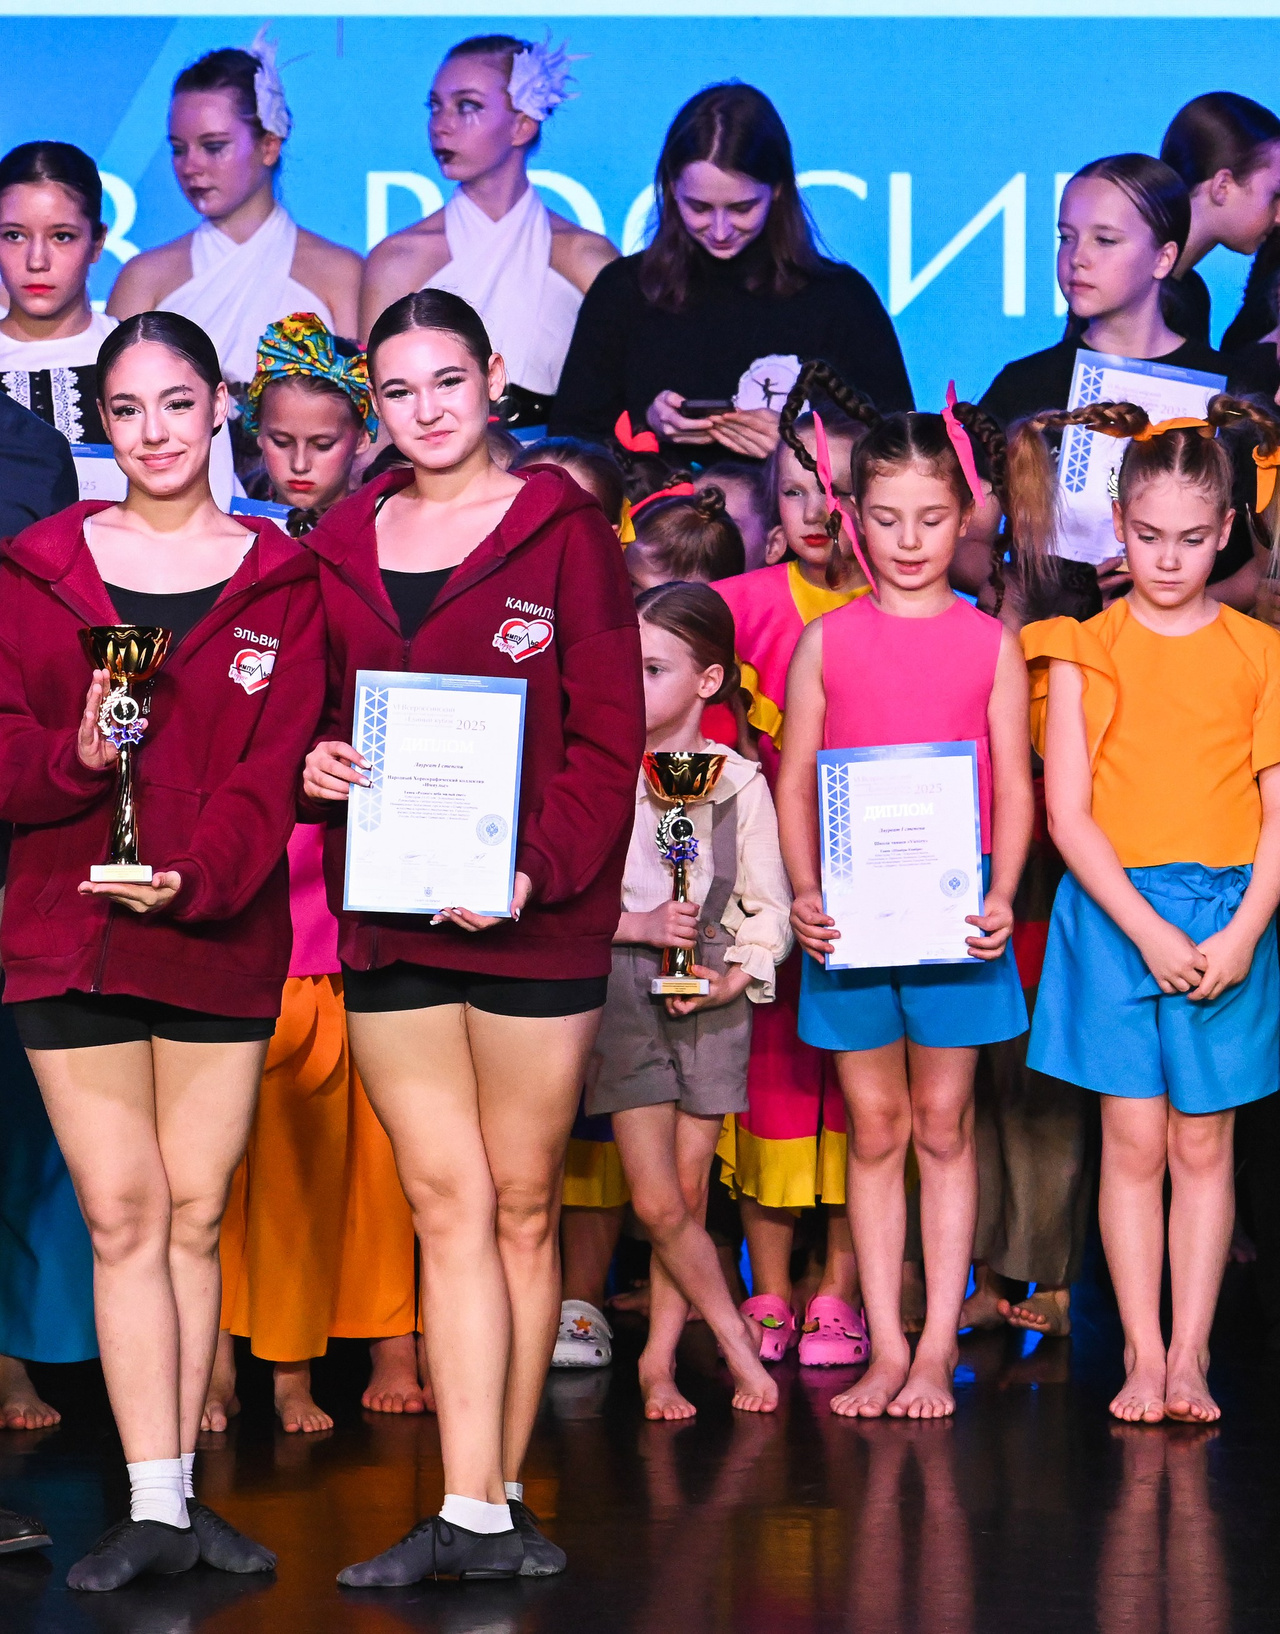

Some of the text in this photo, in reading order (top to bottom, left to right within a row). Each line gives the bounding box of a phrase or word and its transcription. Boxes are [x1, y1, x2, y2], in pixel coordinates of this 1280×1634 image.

[233, 627, 280, 650] ЭЛЬВИ
[456, 719, 486, 731] 2025
[400, 737, 475, 755] ДИПЛОМ
[914, 783, 942, 795] 2025
[863, 802, 934, 822] ДИПЛОМ
